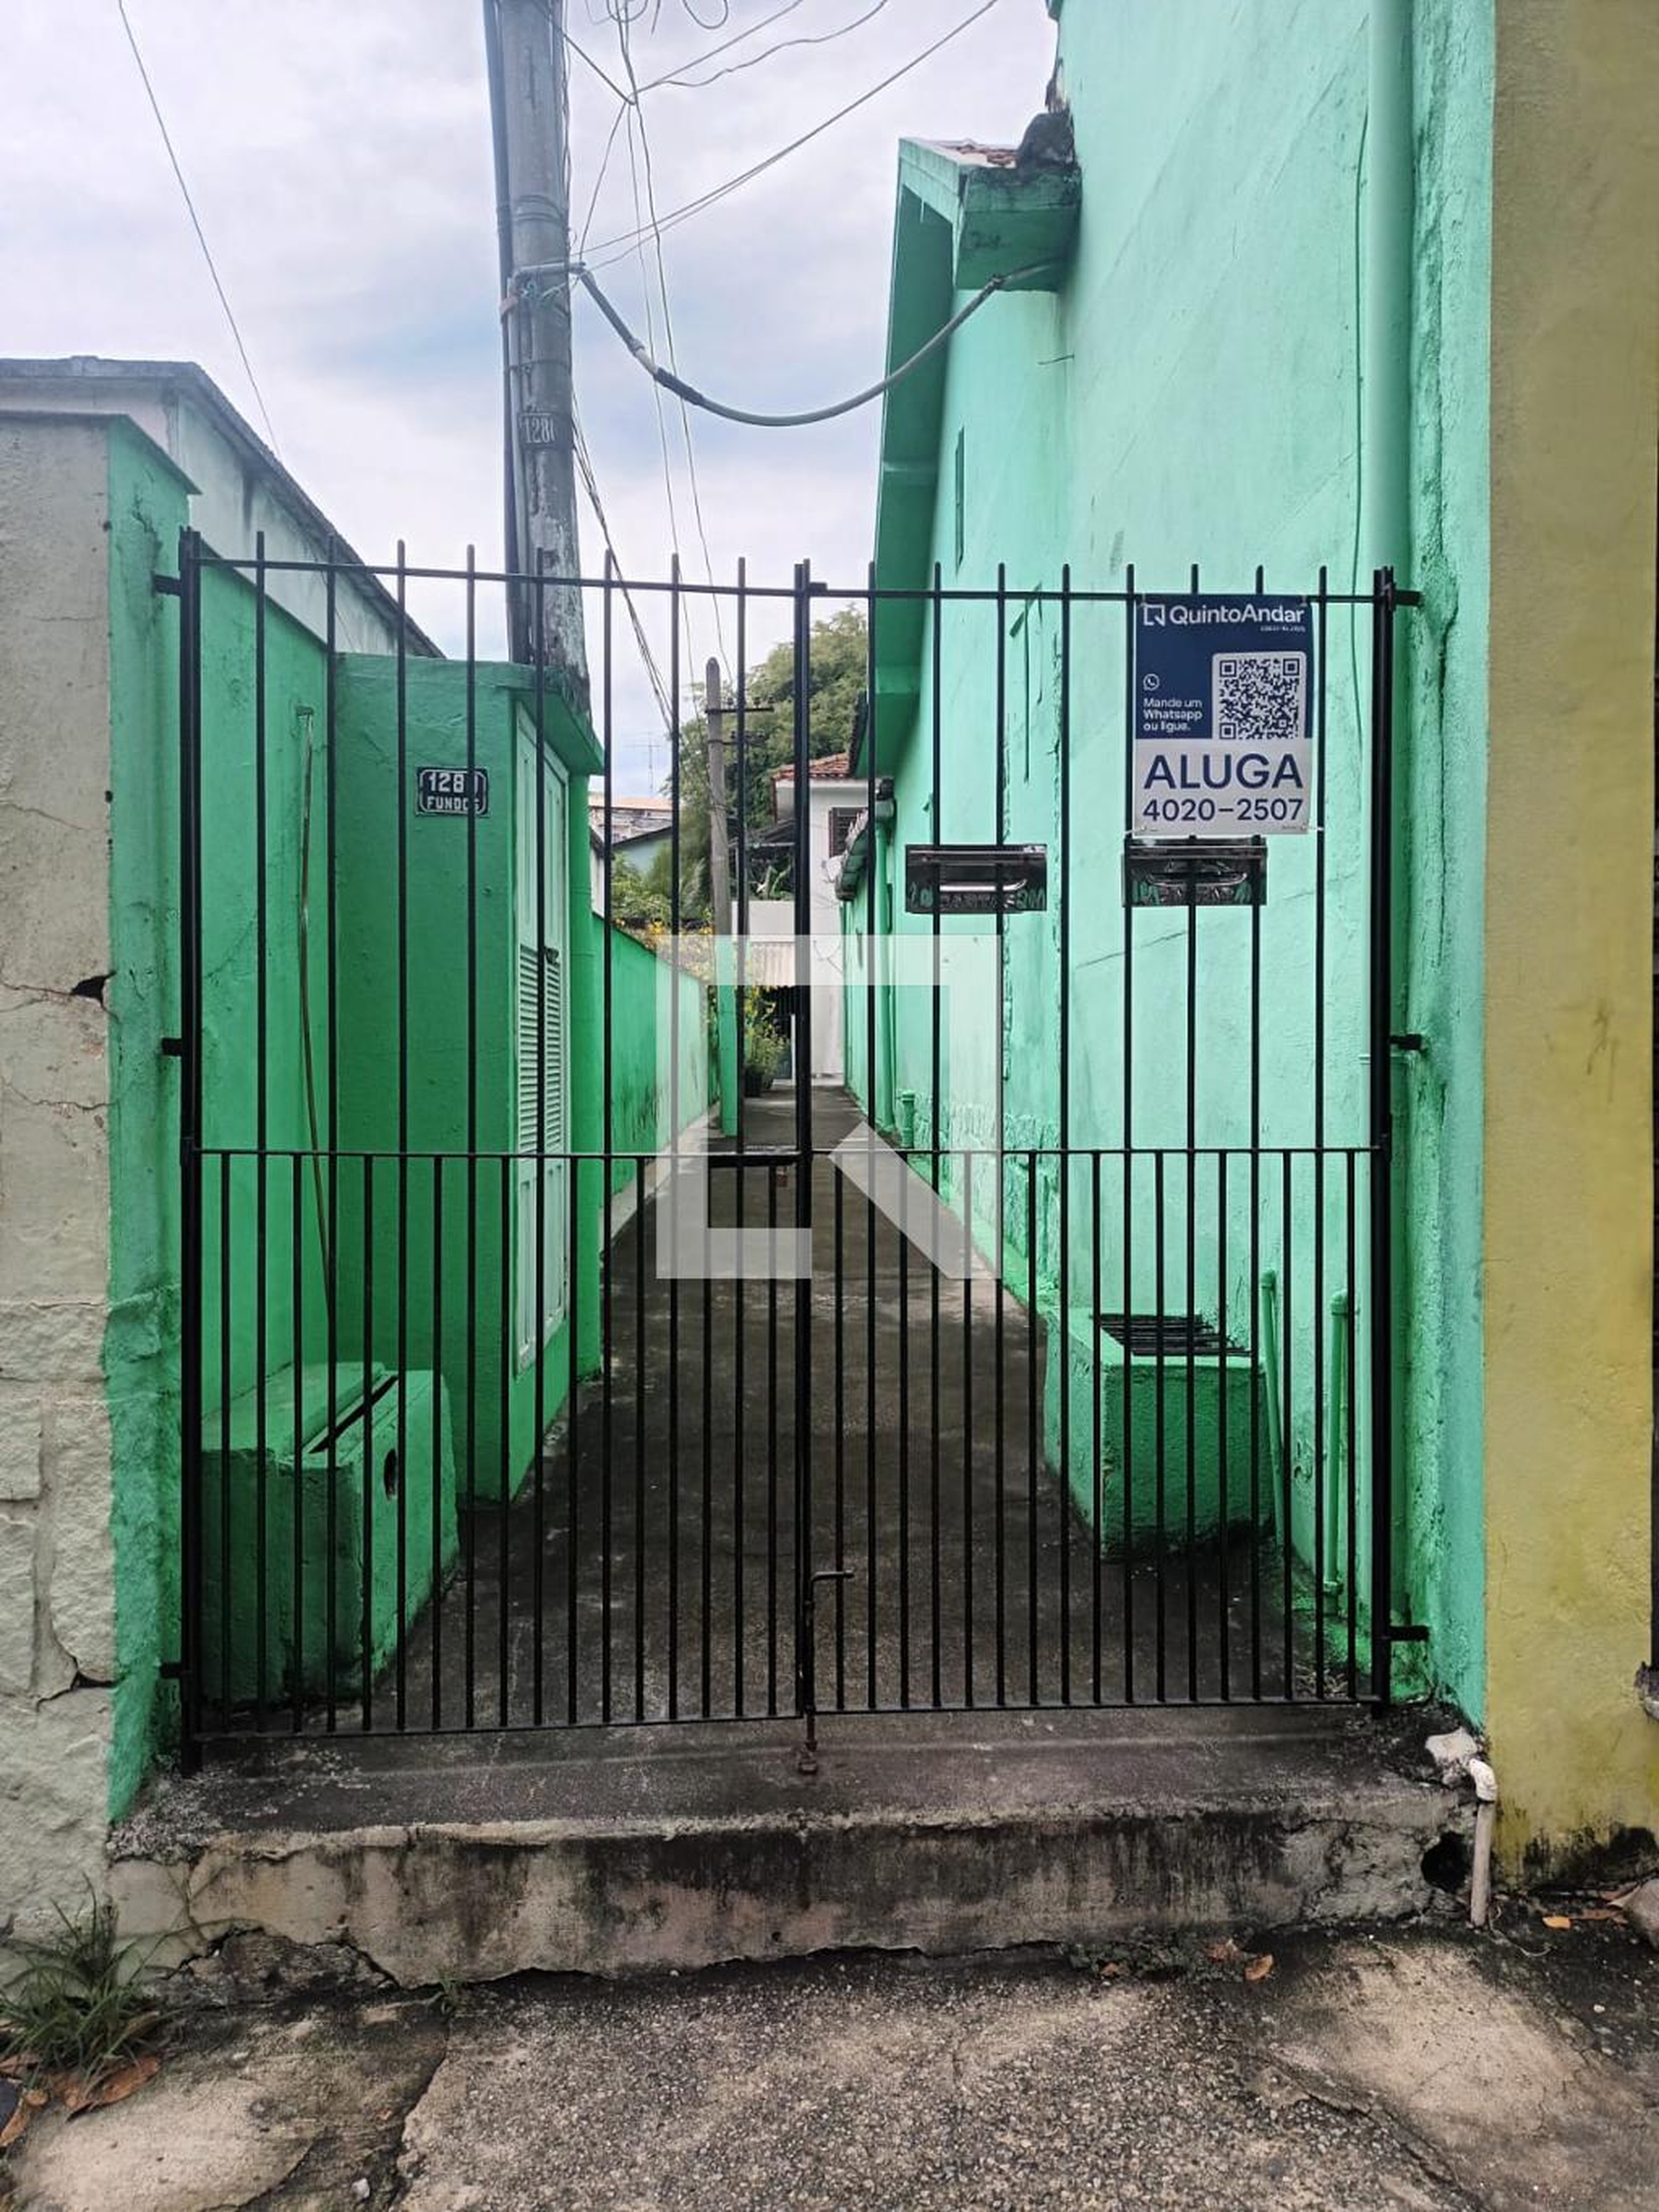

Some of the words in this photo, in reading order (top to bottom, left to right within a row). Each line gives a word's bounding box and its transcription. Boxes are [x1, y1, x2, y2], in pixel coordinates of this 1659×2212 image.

[1169, 604, 1305, 625] QuintoAndar
[1143, 697, 1182, 708] Mande
[1184, 699, 1203, 708] um
[1143, 709, 1203, 722] Whatsapp
[1143, 722, 1158, 731] ou
[1143, 753, 1303, 789] ALUGA
[1143, 798, 1303, 821] 4020-2507
